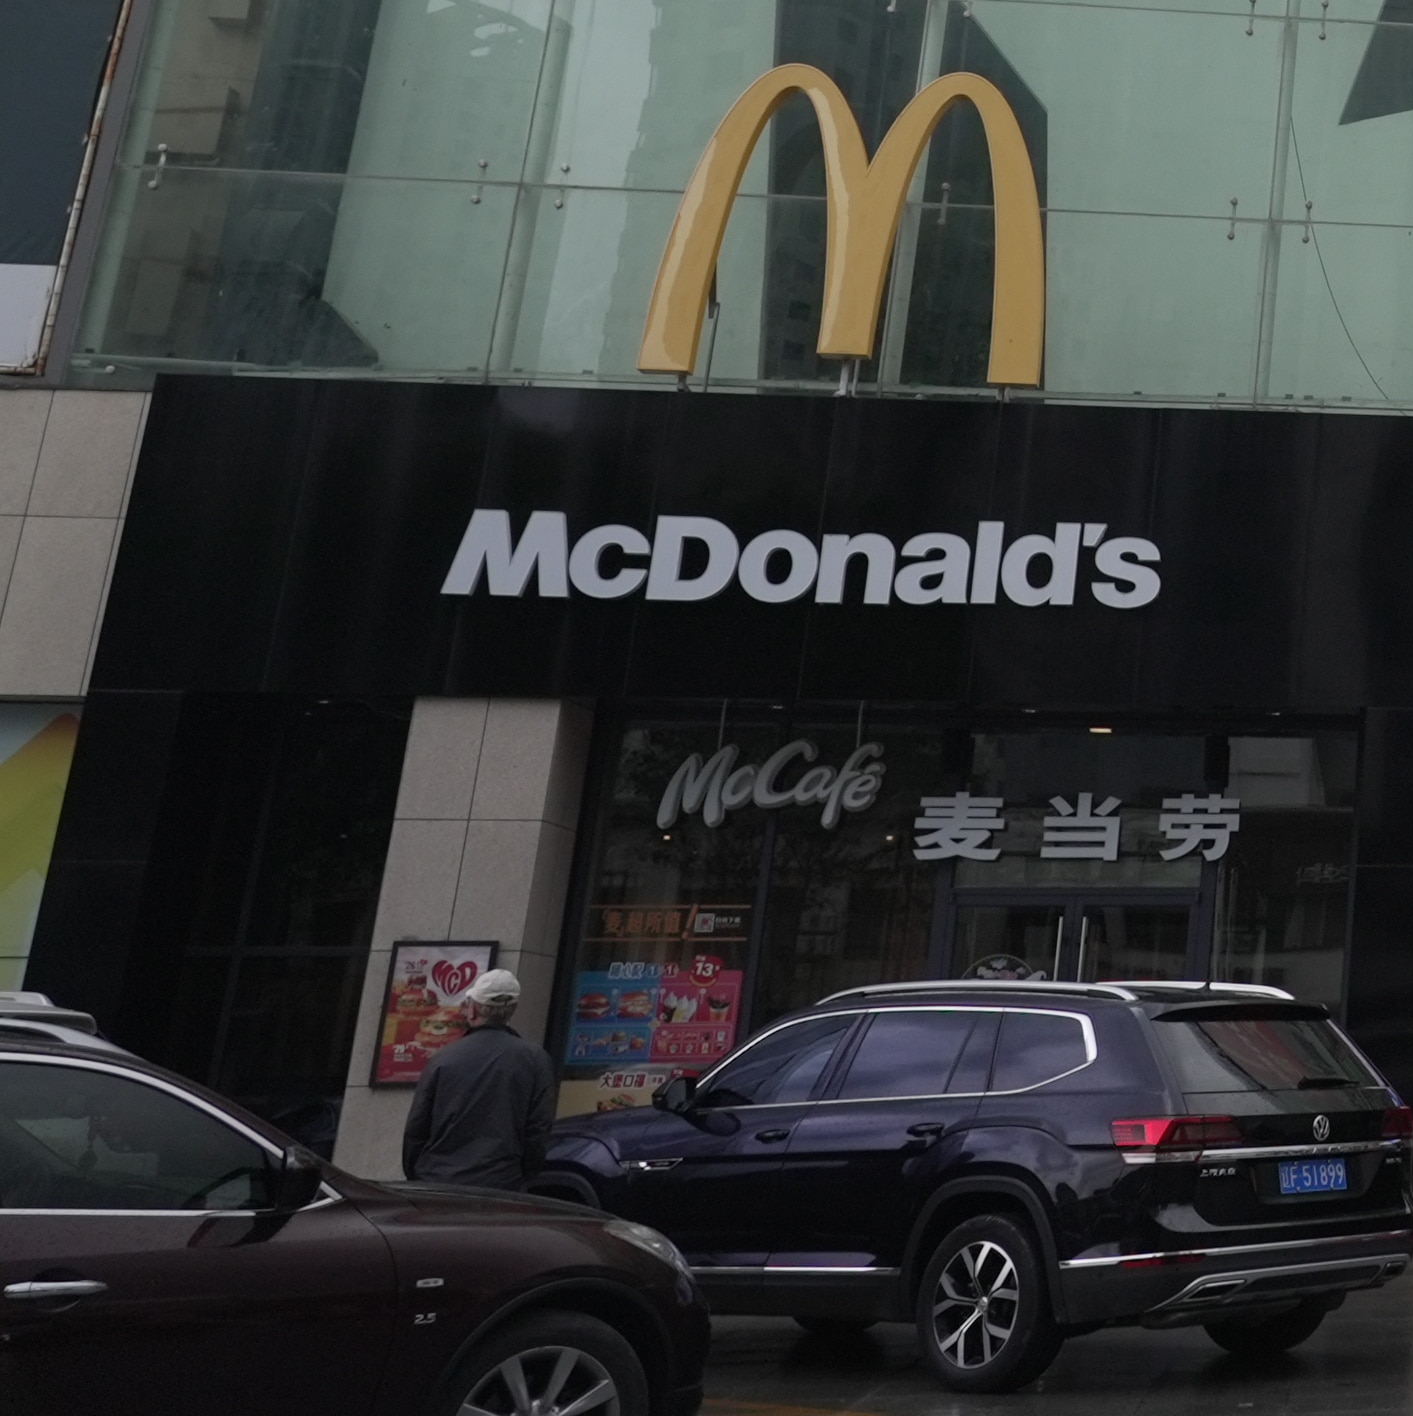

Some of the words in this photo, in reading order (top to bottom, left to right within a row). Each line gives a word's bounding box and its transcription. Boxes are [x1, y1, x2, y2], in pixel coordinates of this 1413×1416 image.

[440, 509, 1163, 609] McDonald's
[656, 740, 887, 832] McCafé
[912, 792, 1242, 863] 麦当劳
